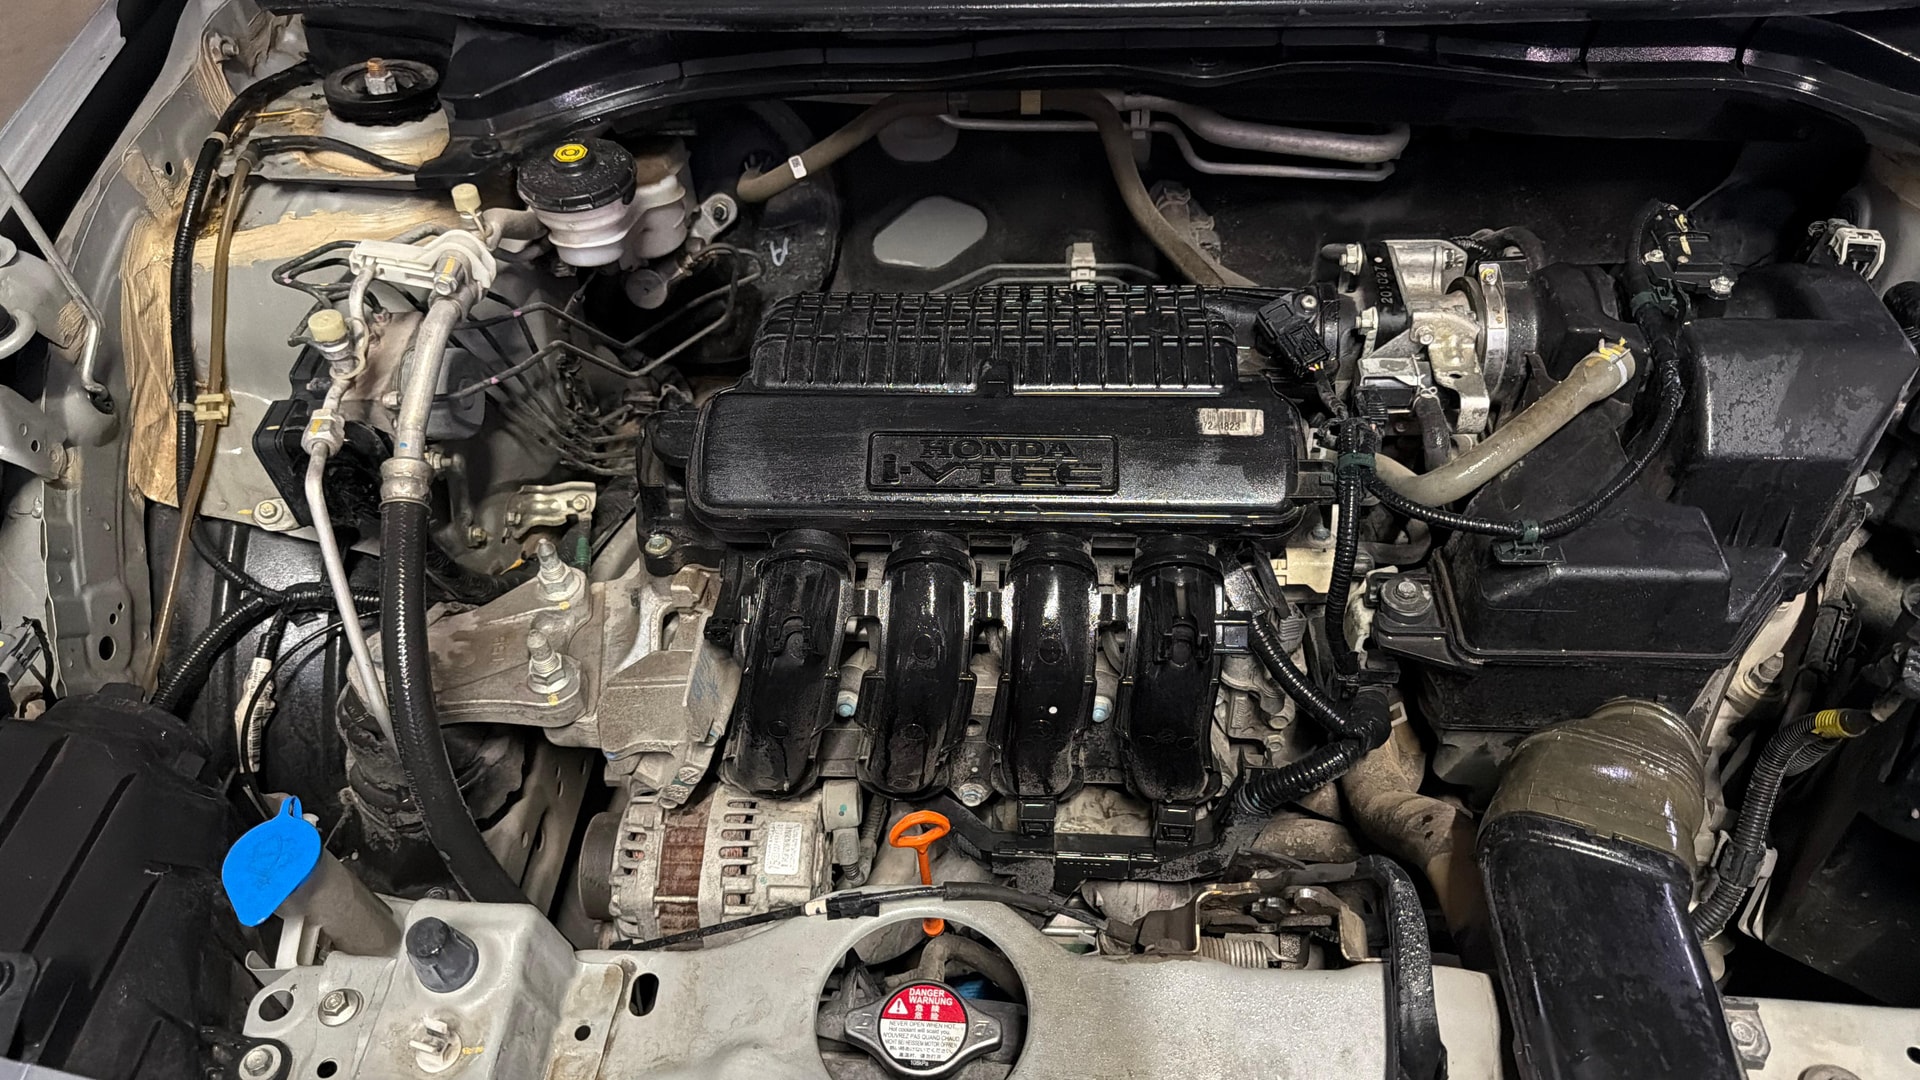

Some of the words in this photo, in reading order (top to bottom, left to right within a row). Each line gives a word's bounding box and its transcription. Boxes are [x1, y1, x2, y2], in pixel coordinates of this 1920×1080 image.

[920, 439, 1078, 462] HONDA
[883, 454, 1102, 487] i-VTEC
[909, 988, 945, 997] DANGER
[908, 996, 953, 1006] WARNUNG
